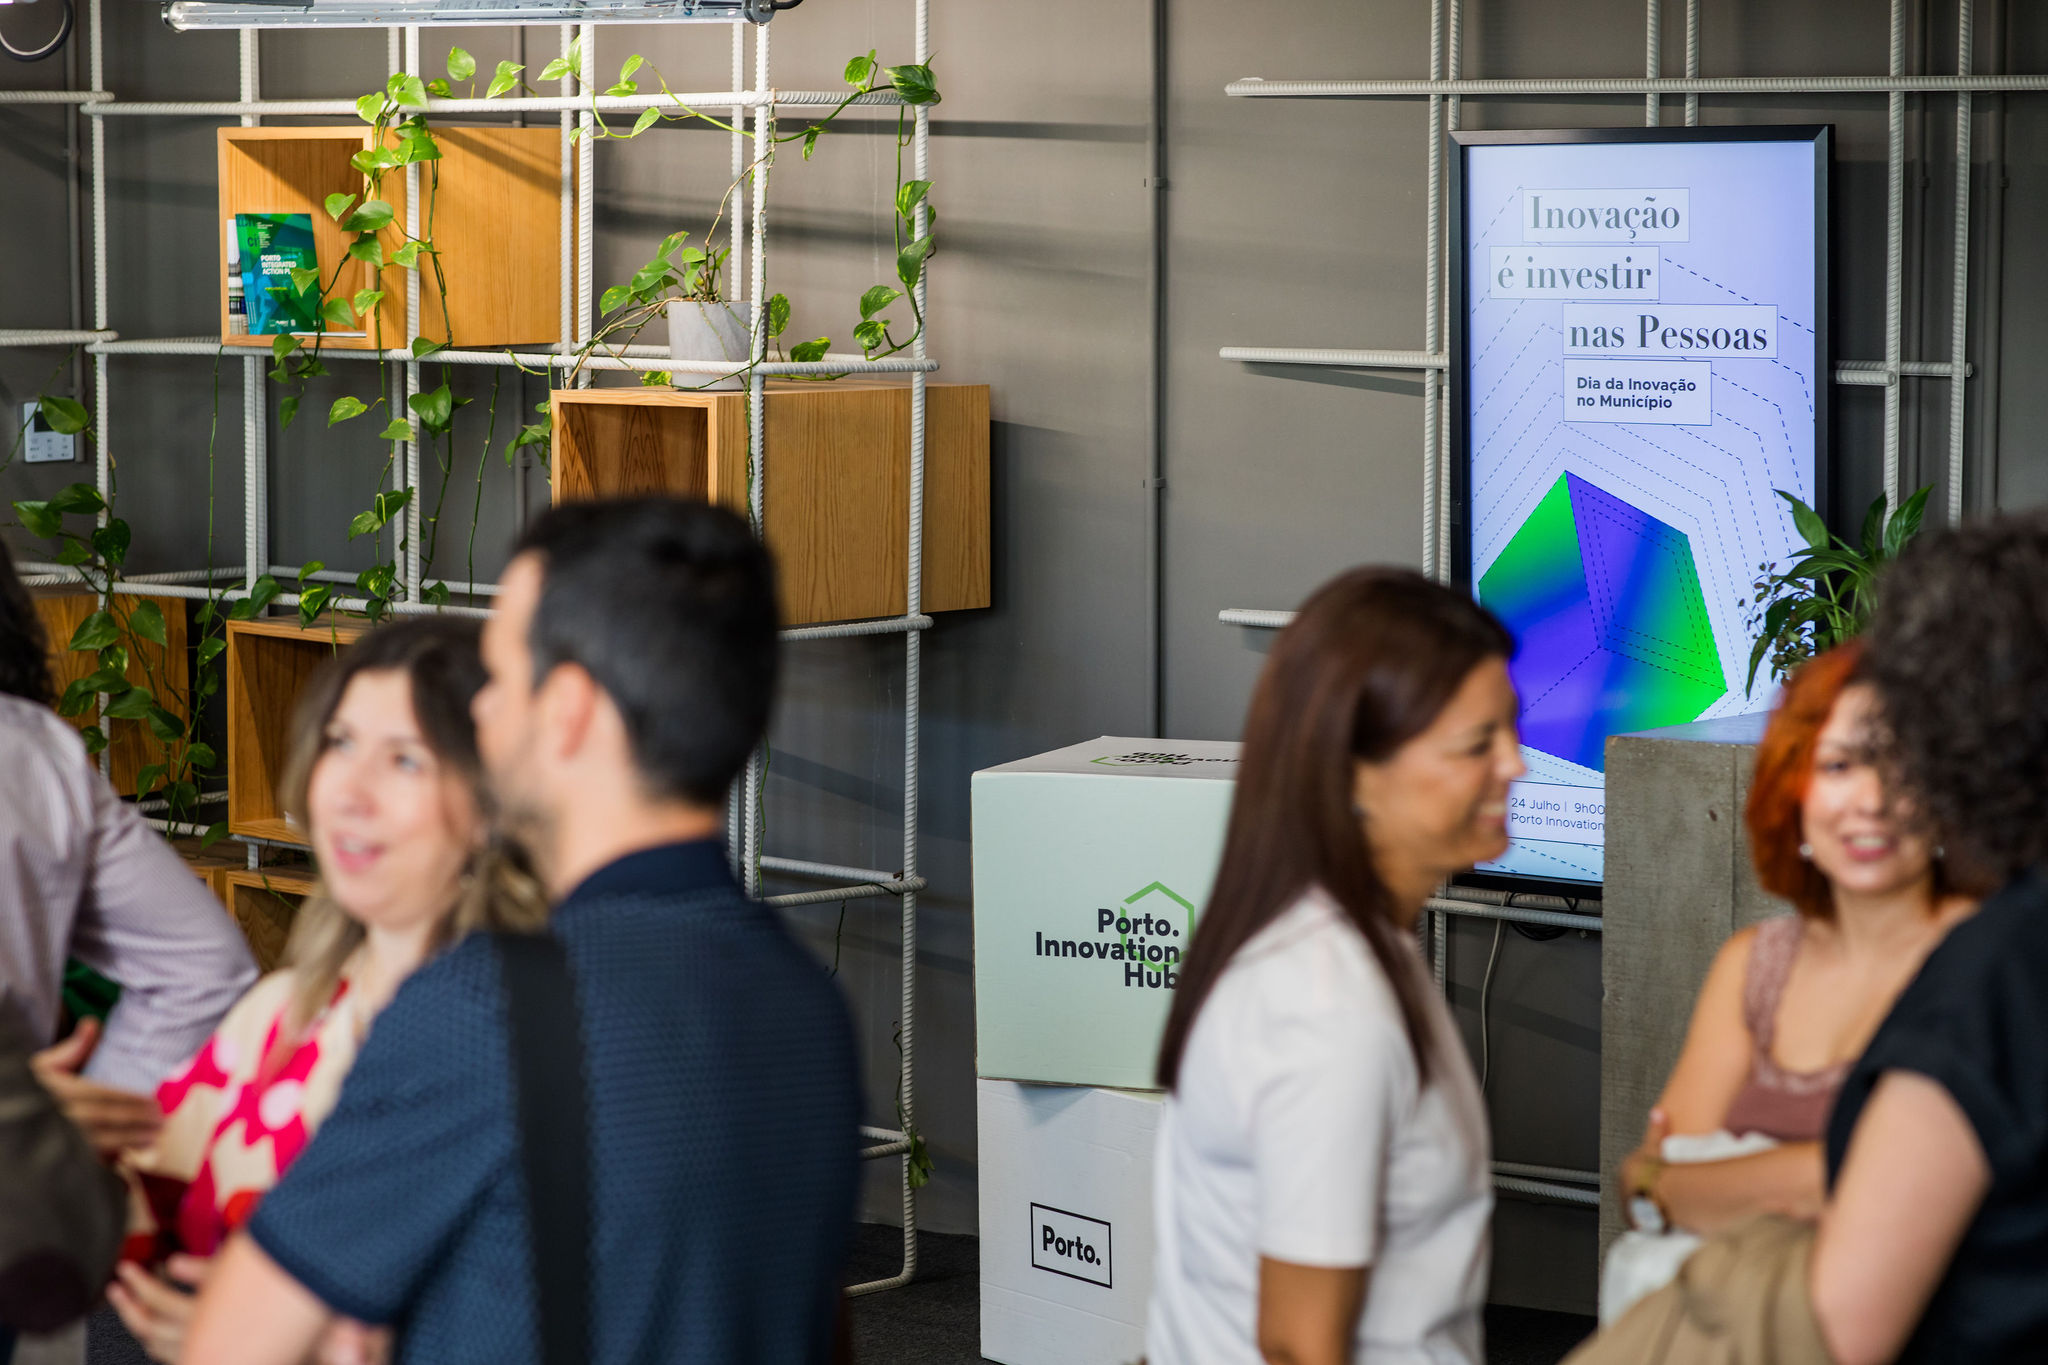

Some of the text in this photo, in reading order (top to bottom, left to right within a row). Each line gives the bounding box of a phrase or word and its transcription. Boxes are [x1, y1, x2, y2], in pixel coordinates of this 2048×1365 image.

[1529, 195, 1681, 239] Inovação
[1497, 255, 1652, 290] é investir
[1569, 314, 1768, 351] nas Pessoas
[1576, 377, 1697, 394] Dia da Inovação
[1576, 394, 1673, 411] no Município
[1511, 797, 1526, 808] 24
[1529, 799, 1561, 812] Julho
[1574, 802, 1605, 815] 9h00
[1511, 812, 1605, 831] Porto Innovation
[1098, 908, 1180, 937] Porto.
[1036, 931, 1180, 963] Innovation
[1124, 962, 1180, 989] Hub
[1042, 1224, 1101, 1266] Porto.
